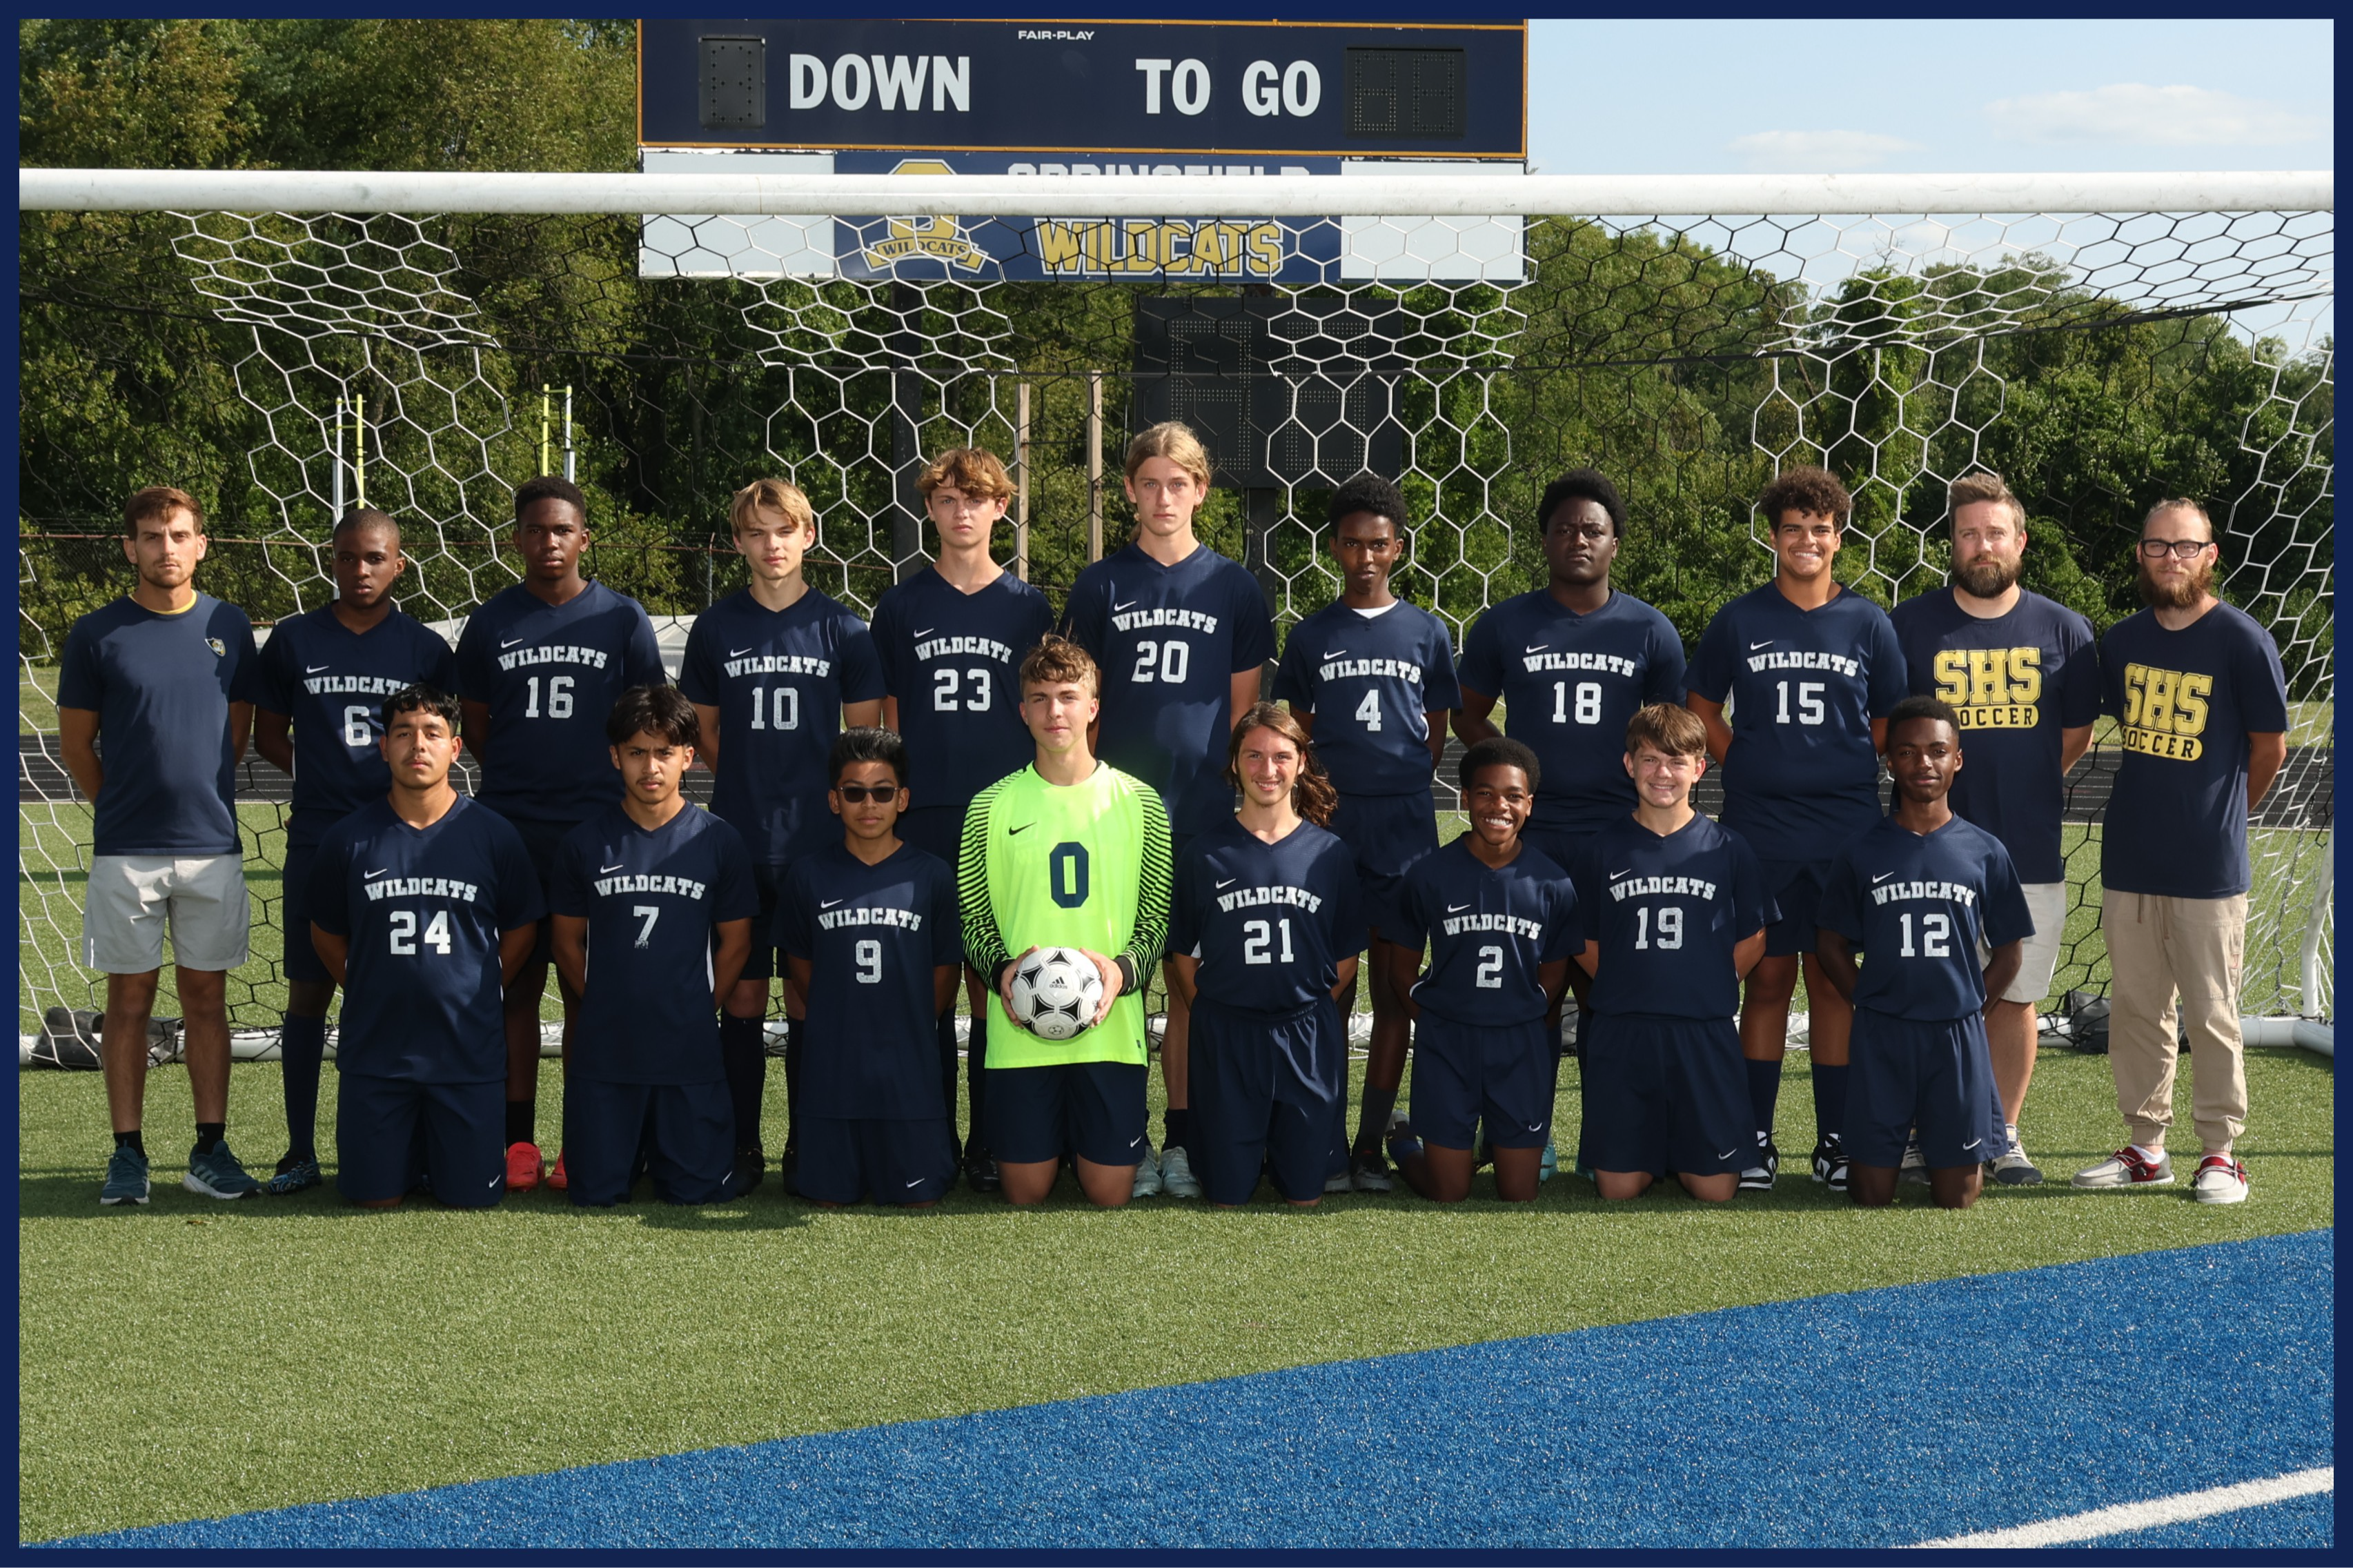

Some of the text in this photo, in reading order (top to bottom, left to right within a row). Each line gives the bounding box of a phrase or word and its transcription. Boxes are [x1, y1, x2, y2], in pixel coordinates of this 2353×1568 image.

[1018, 30, 1094, 40] FAIR-PLAY
[789, 54, 1321, 117] DOWN TO GO
[882, 240, 967, 256] WILDCATS
[1034, 218, 1283, 277] WILDCATS
[1112, 608, 1218, 634] WILDCATS
[498, 646, 608, 670] WILDCATS
[725, 656, 830, 677] WILDCATS
[914, 636, 1012, 664] WILDCATS
[1132, 641, 1190, 683] 20
[1523, 653, 1635, 677] WILDCATS
[1747, 651, 1859, 677] WILDCATS
[934, 668, 991, 711] 23
[1319, 659, 1421, 684] WILDCATS
[1934, 647, 2042, 706] SHS
[525, 676, 575, 718] 16
[751, 687, 798, 730] 10
[1355, 689, 1381, 731] 4
[1553, 682, 1602, 724] 18
[1776, 681, 1825, 725] 15
[2123, 662, 2213, 737] SHS
[344, 705, 372, 746] 6
[364, 877, 478, 902] WILDCATS
[594, 874, 705, 900] WILDCATS
[1050, 841, 1089, 909] 0
[1609, 876, 1716, 902] WILDCATS
[1871, 881, 1976, 907] WILDCATS
[818, 908, 922, 931] WILDCATS
[1217, 886, 1322, 913] WILDCATS
[390, 911, 451, 955] 24
[633, 905, 659, 949] 7
[1243, 918, 1294, 964] 21
[1443, 913, 1542, 940] WILDCATS
[1635, 907, 1683, 950] 19
[1900, 913, 1950, 957] 12
[856, 940, 882, 984] 9
[1476, 946, 1504, 989] 2
